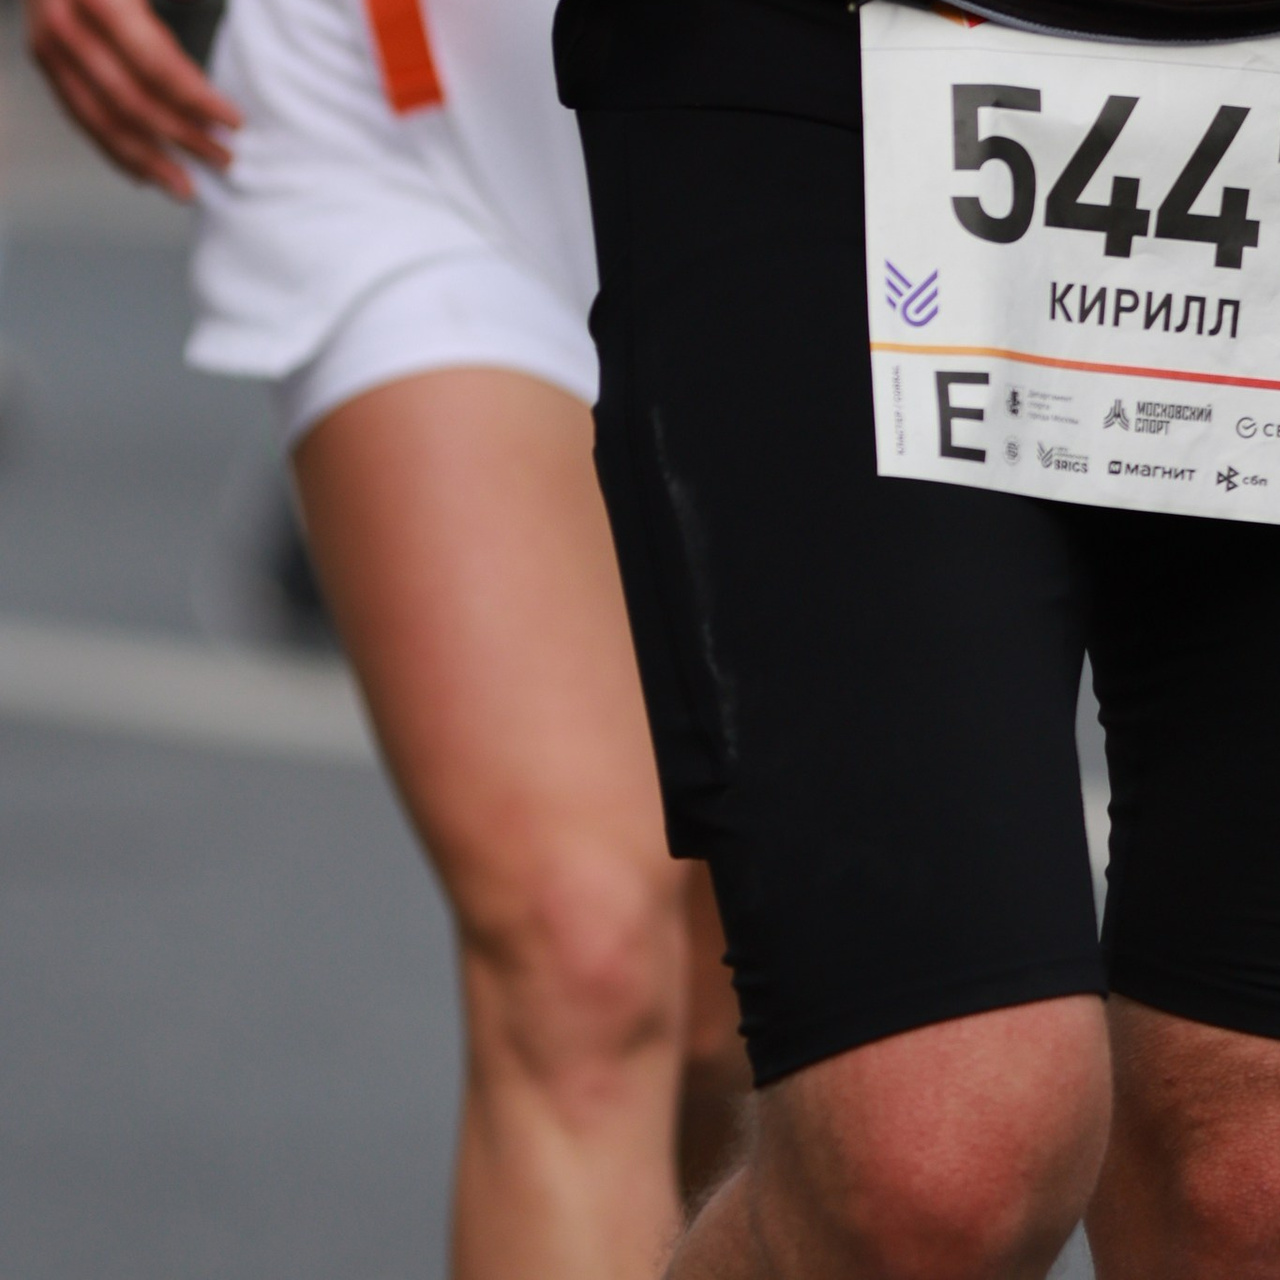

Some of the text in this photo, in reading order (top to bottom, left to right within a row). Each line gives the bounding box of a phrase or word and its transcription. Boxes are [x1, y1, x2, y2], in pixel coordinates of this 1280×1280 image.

[1049, 280, 1241, 339] КИРИЛЛ
[934, 370, 990, 464] E
[1137, 401, 1213, 423] МОСКОВСКИЙ
[1134, 418, 1170, 435] СПОРТ
[1054, 459, 1089, 474] BRICS
[1125, 463, 1196, 481] магнит
[1242, 474, 1268, 486] сбп
